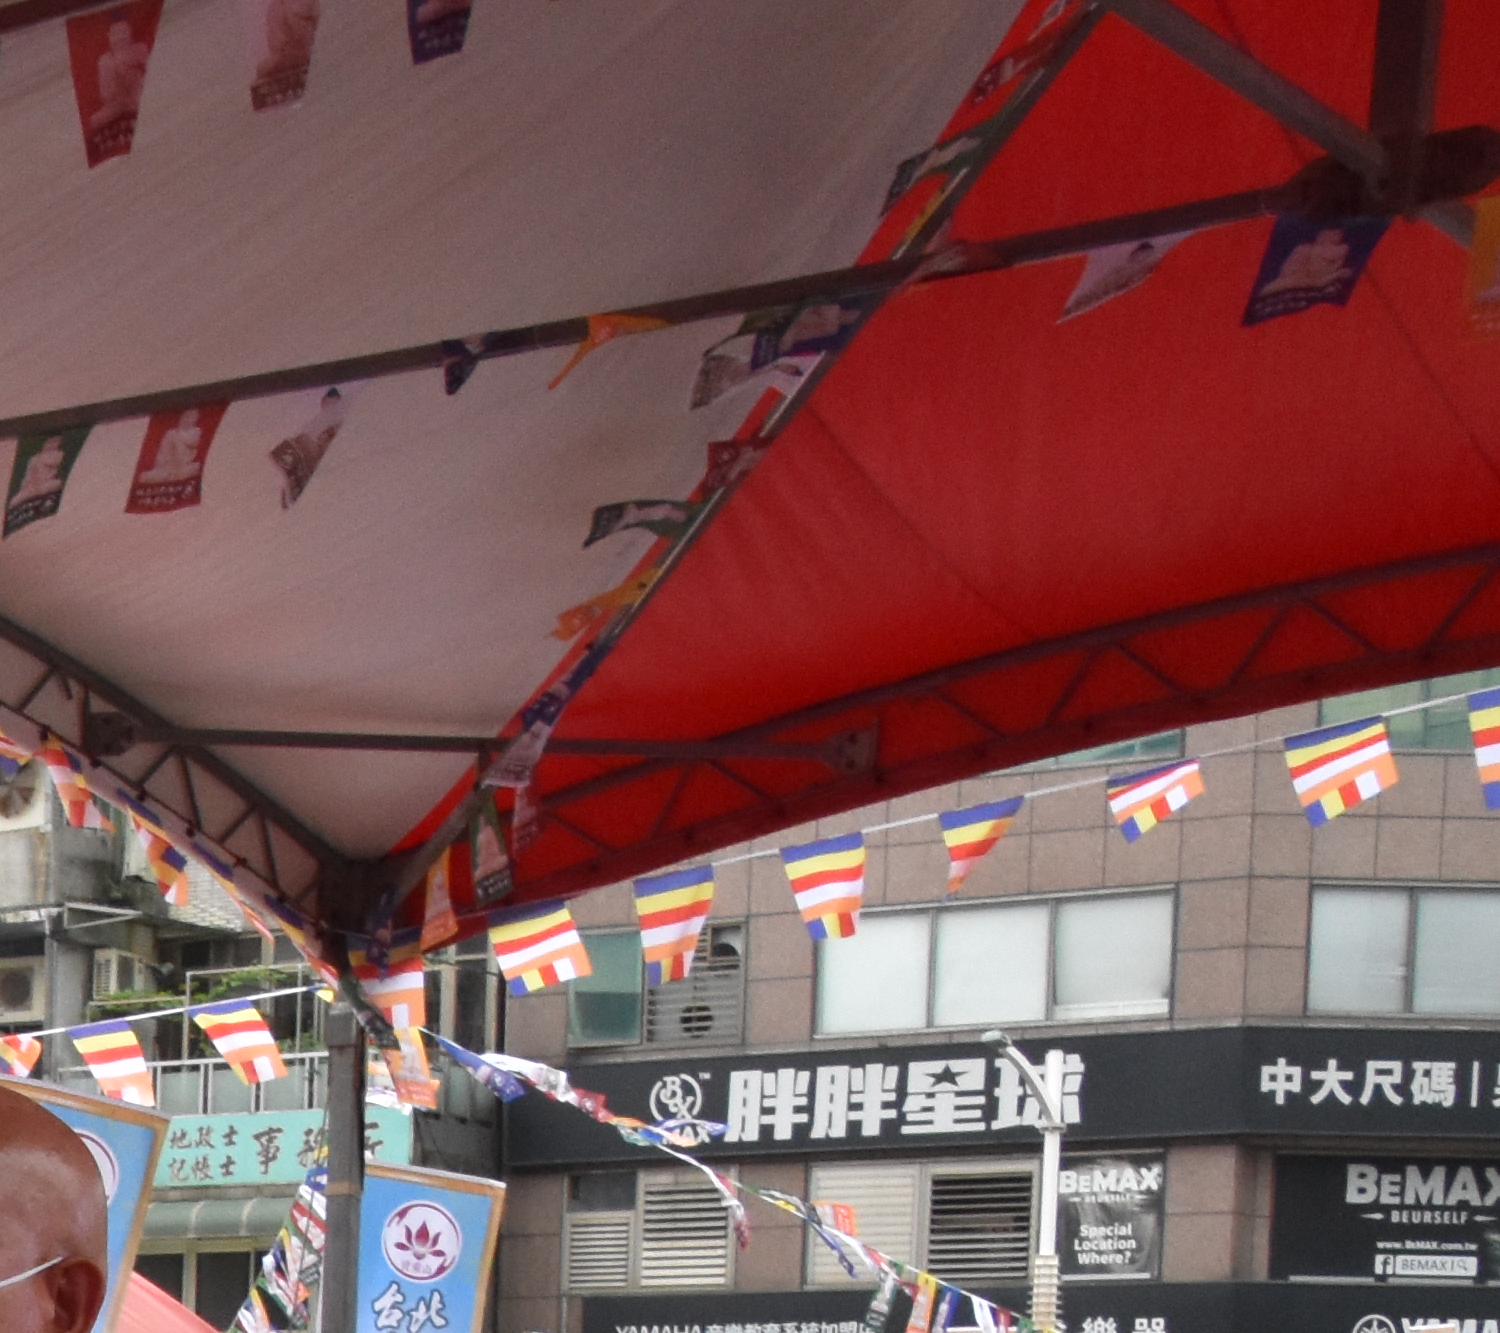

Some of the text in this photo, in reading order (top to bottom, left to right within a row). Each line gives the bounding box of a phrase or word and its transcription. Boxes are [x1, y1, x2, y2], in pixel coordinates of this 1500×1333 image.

[1260, 1057, 1457, 1108] 中大尺碼
[724, 1056, 1084, 1143] 胖胖星球
[170, 1125, 238, 1150] 地政士
[1390, 1210, 1469, 1224] BEURSELF
[1080, 1223, 1132, 1238] Special
[1074, 1238, 1136, 1251] Location
[1078, 1252, 1131, 1265] Where?
[373, 1280, 449, 1333] 台北
